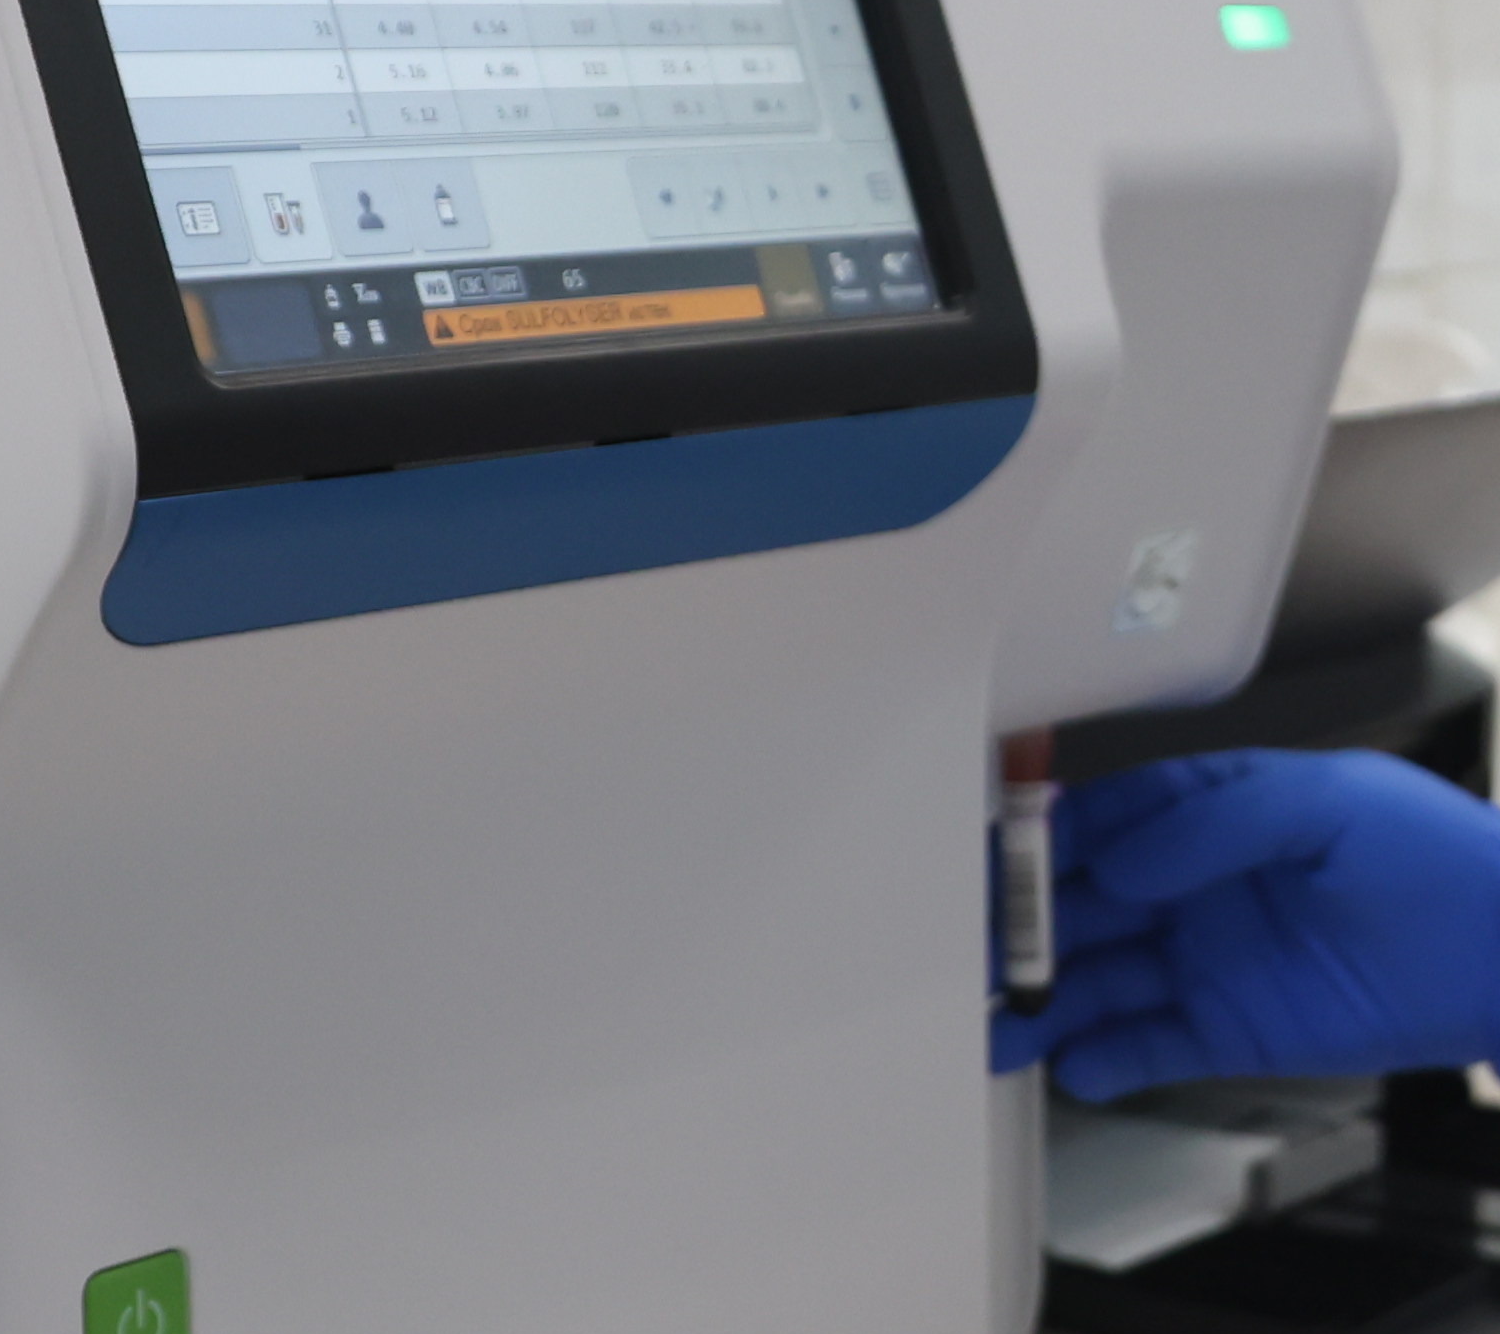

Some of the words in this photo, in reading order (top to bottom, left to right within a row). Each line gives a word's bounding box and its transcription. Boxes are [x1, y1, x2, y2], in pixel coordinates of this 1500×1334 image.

[313, 20, 333, 36] 31
[424, 277, 448, 297] WB
[458, 273, 486, 294] CBC
[561, 267, 585, 291] 65
